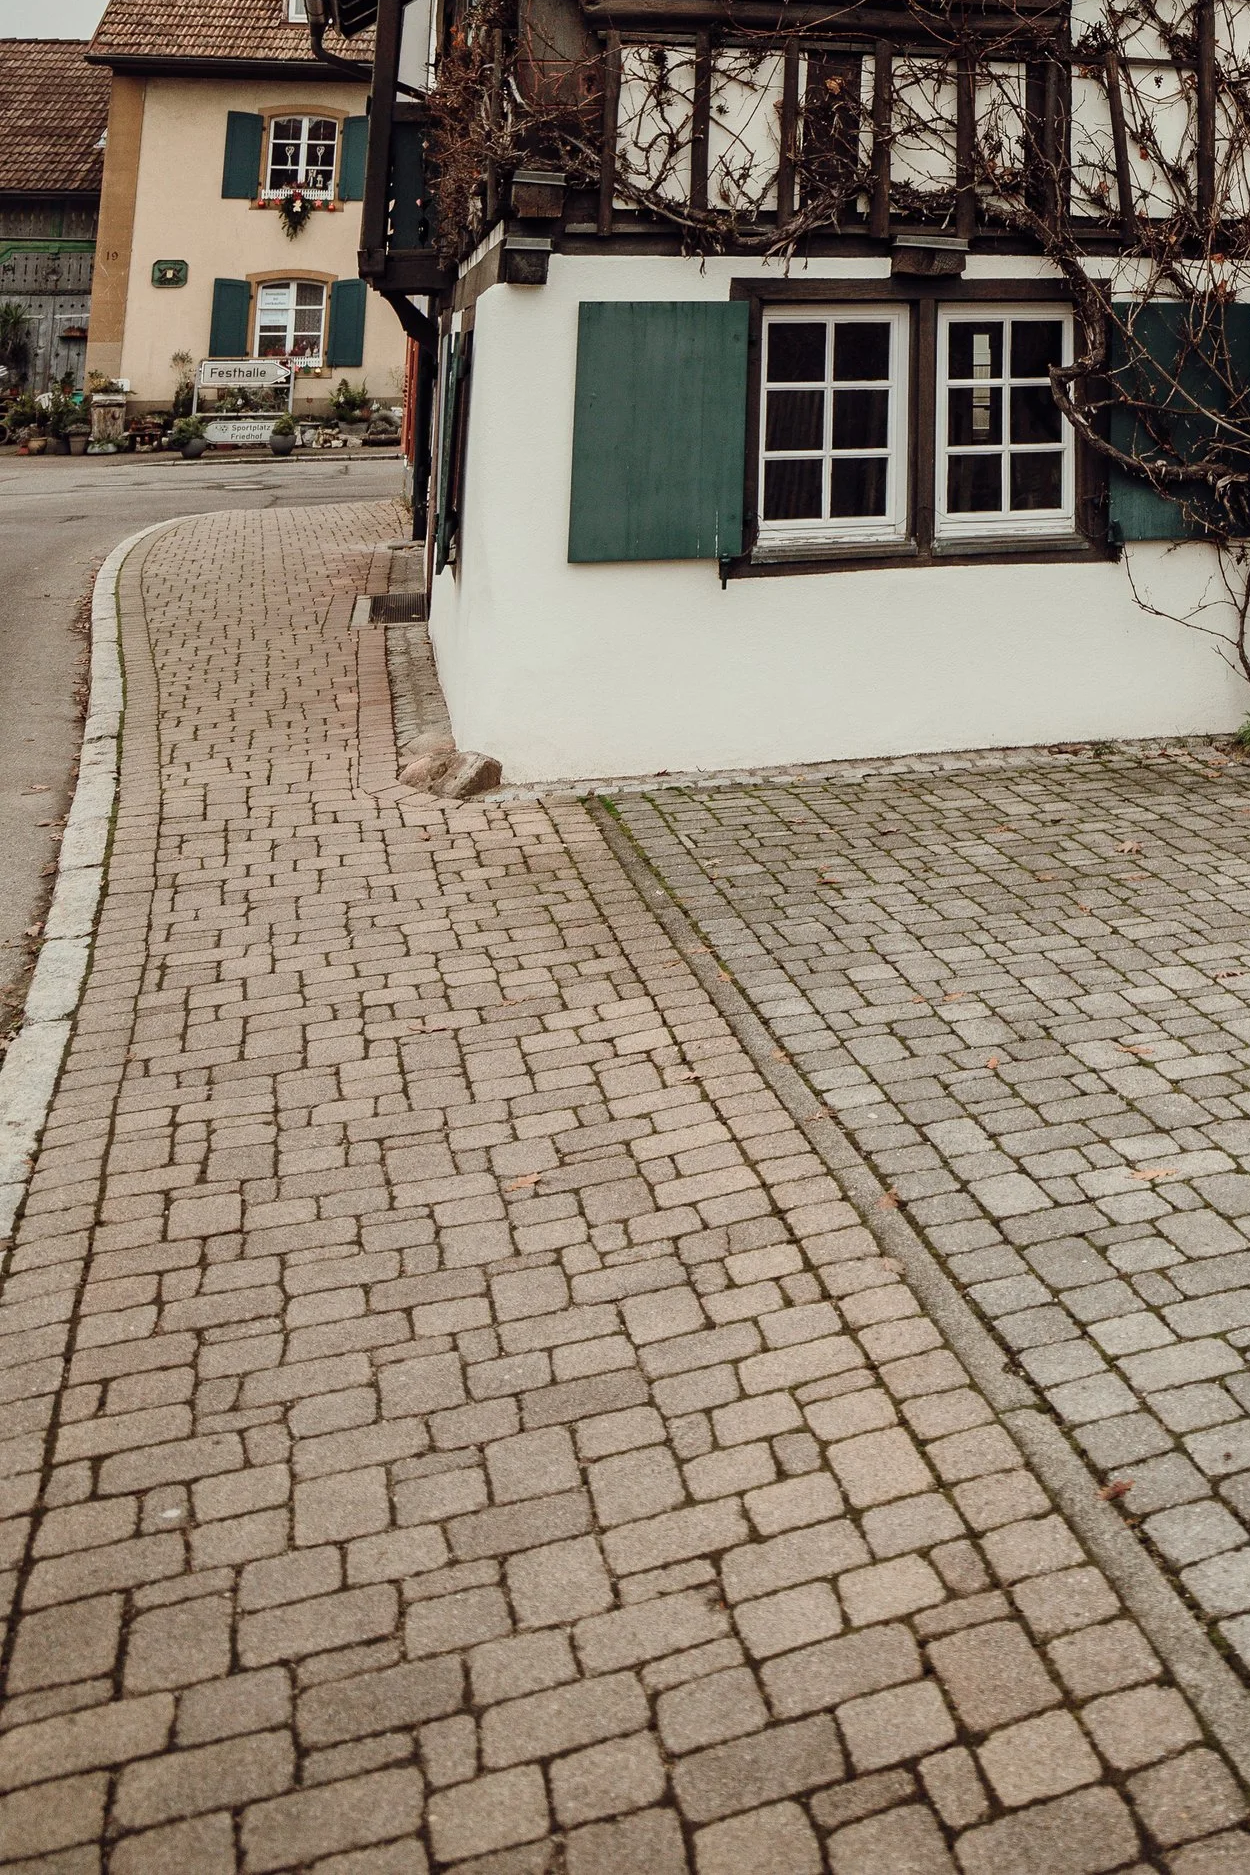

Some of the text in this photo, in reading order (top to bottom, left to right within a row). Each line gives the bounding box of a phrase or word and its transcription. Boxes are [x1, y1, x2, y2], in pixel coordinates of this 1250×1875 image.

[106, 251, 119, 261] 19
[210, 367, 267, 378] Festhalle
[231, 424, 271, 432] Sportplatz
